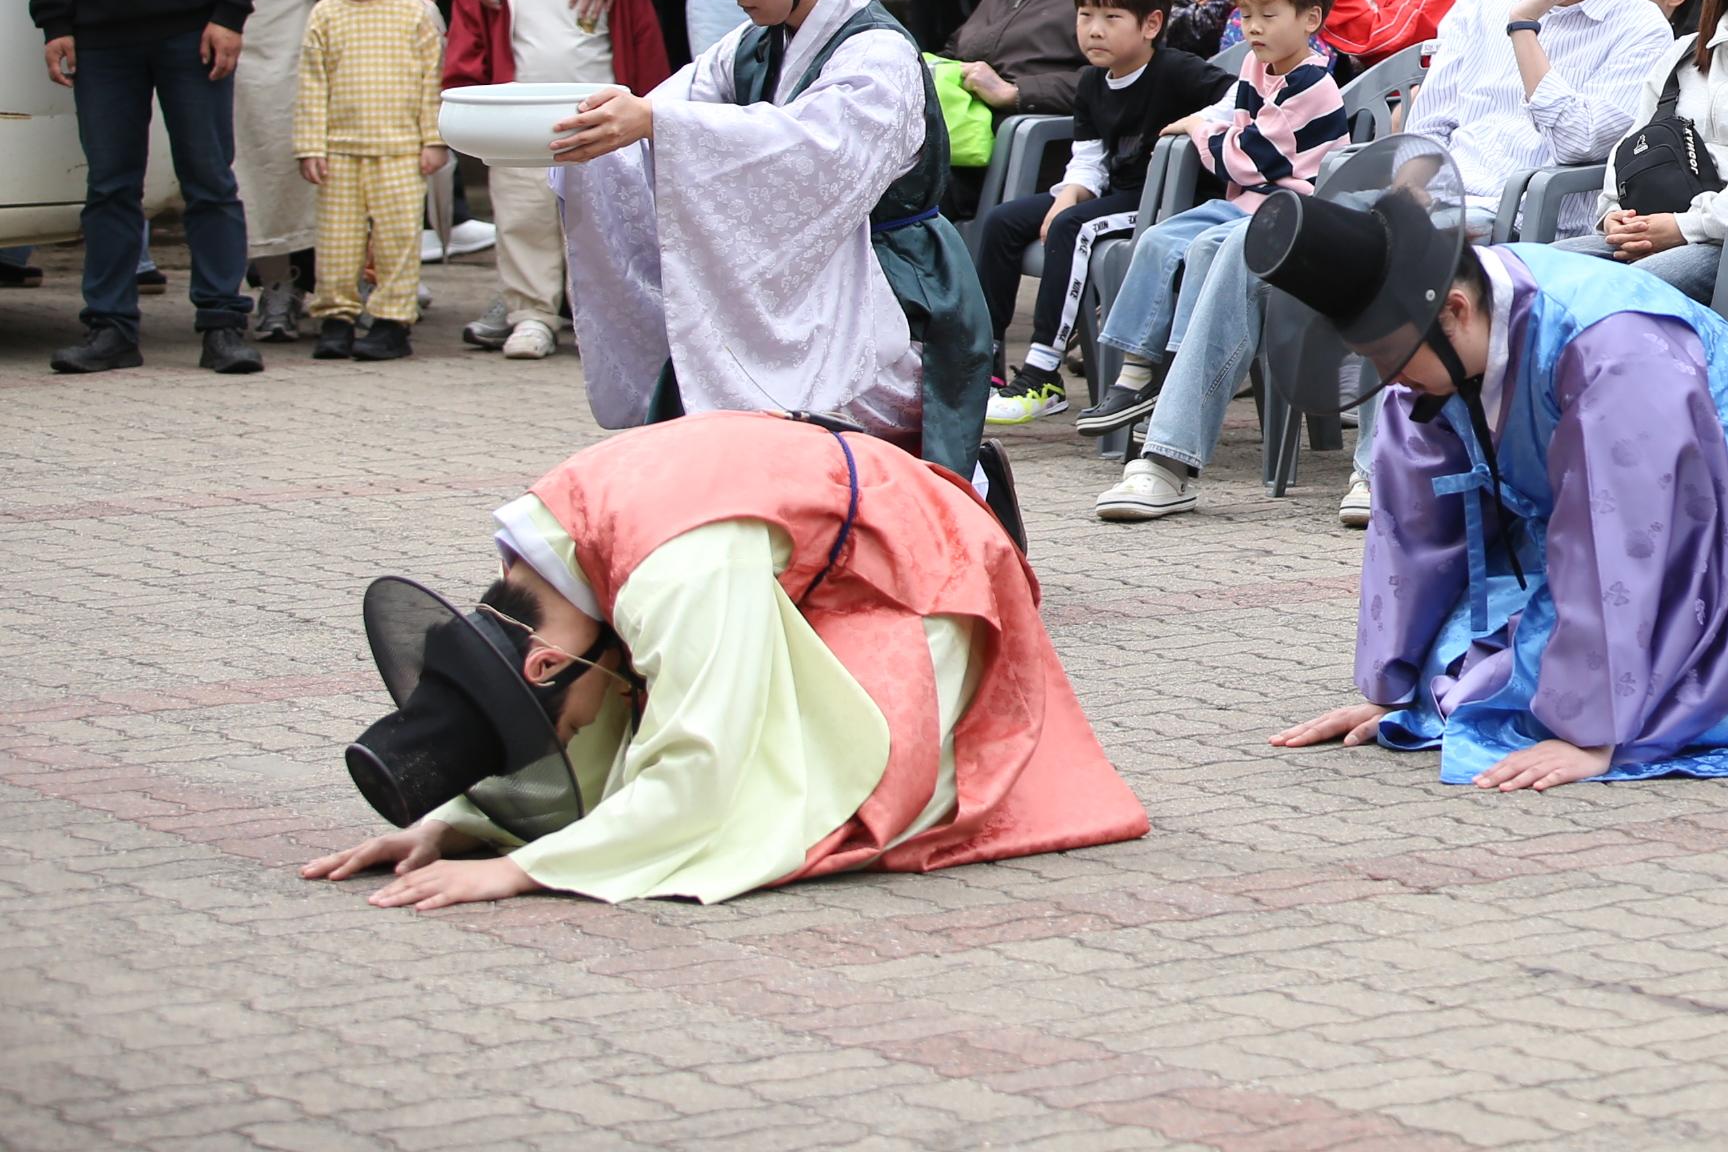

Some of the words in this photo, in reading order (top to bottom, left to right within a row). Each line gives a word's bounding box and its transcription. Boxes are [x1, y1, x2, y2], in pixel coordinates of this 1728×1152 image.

[1092, 219, 1109, 233] NIKE
[1079, 235, 1090, 256] NIKE
[1070, 279, 1082, 301] NIKE
[1059, 323, 1071, 345] NIKE
